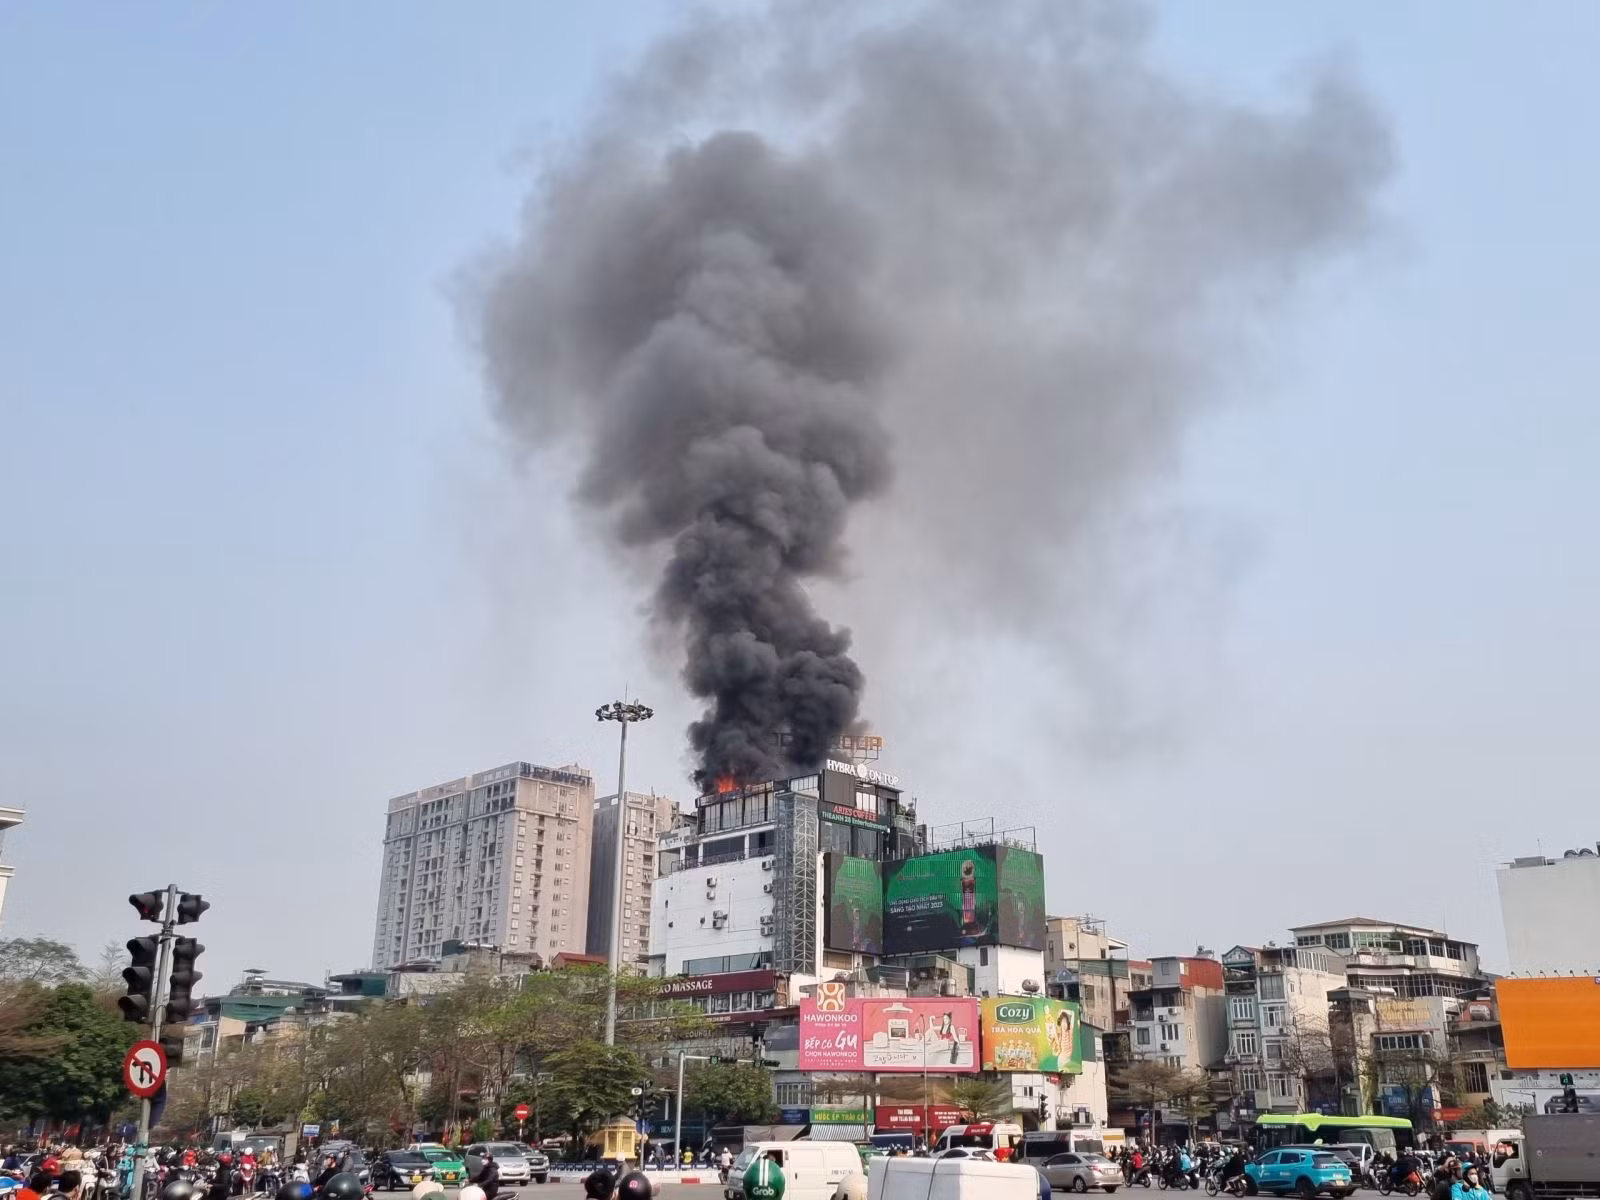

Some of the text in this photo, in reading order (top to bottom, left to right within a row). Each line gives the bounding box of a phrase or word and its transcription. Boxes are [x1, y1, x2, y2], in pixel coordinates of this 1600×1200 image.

[827, 760, 899, 786] HYBRA ON TOP
[852, 809, 877, 822] COFFEE
[672, 980, 713, 992] MASSAGE
[803, 1014, 858, 1022] HAWONKOO
[999, 1006, 1030, 1020] Cozy
[752, 1186, 775, 1196] Grab
